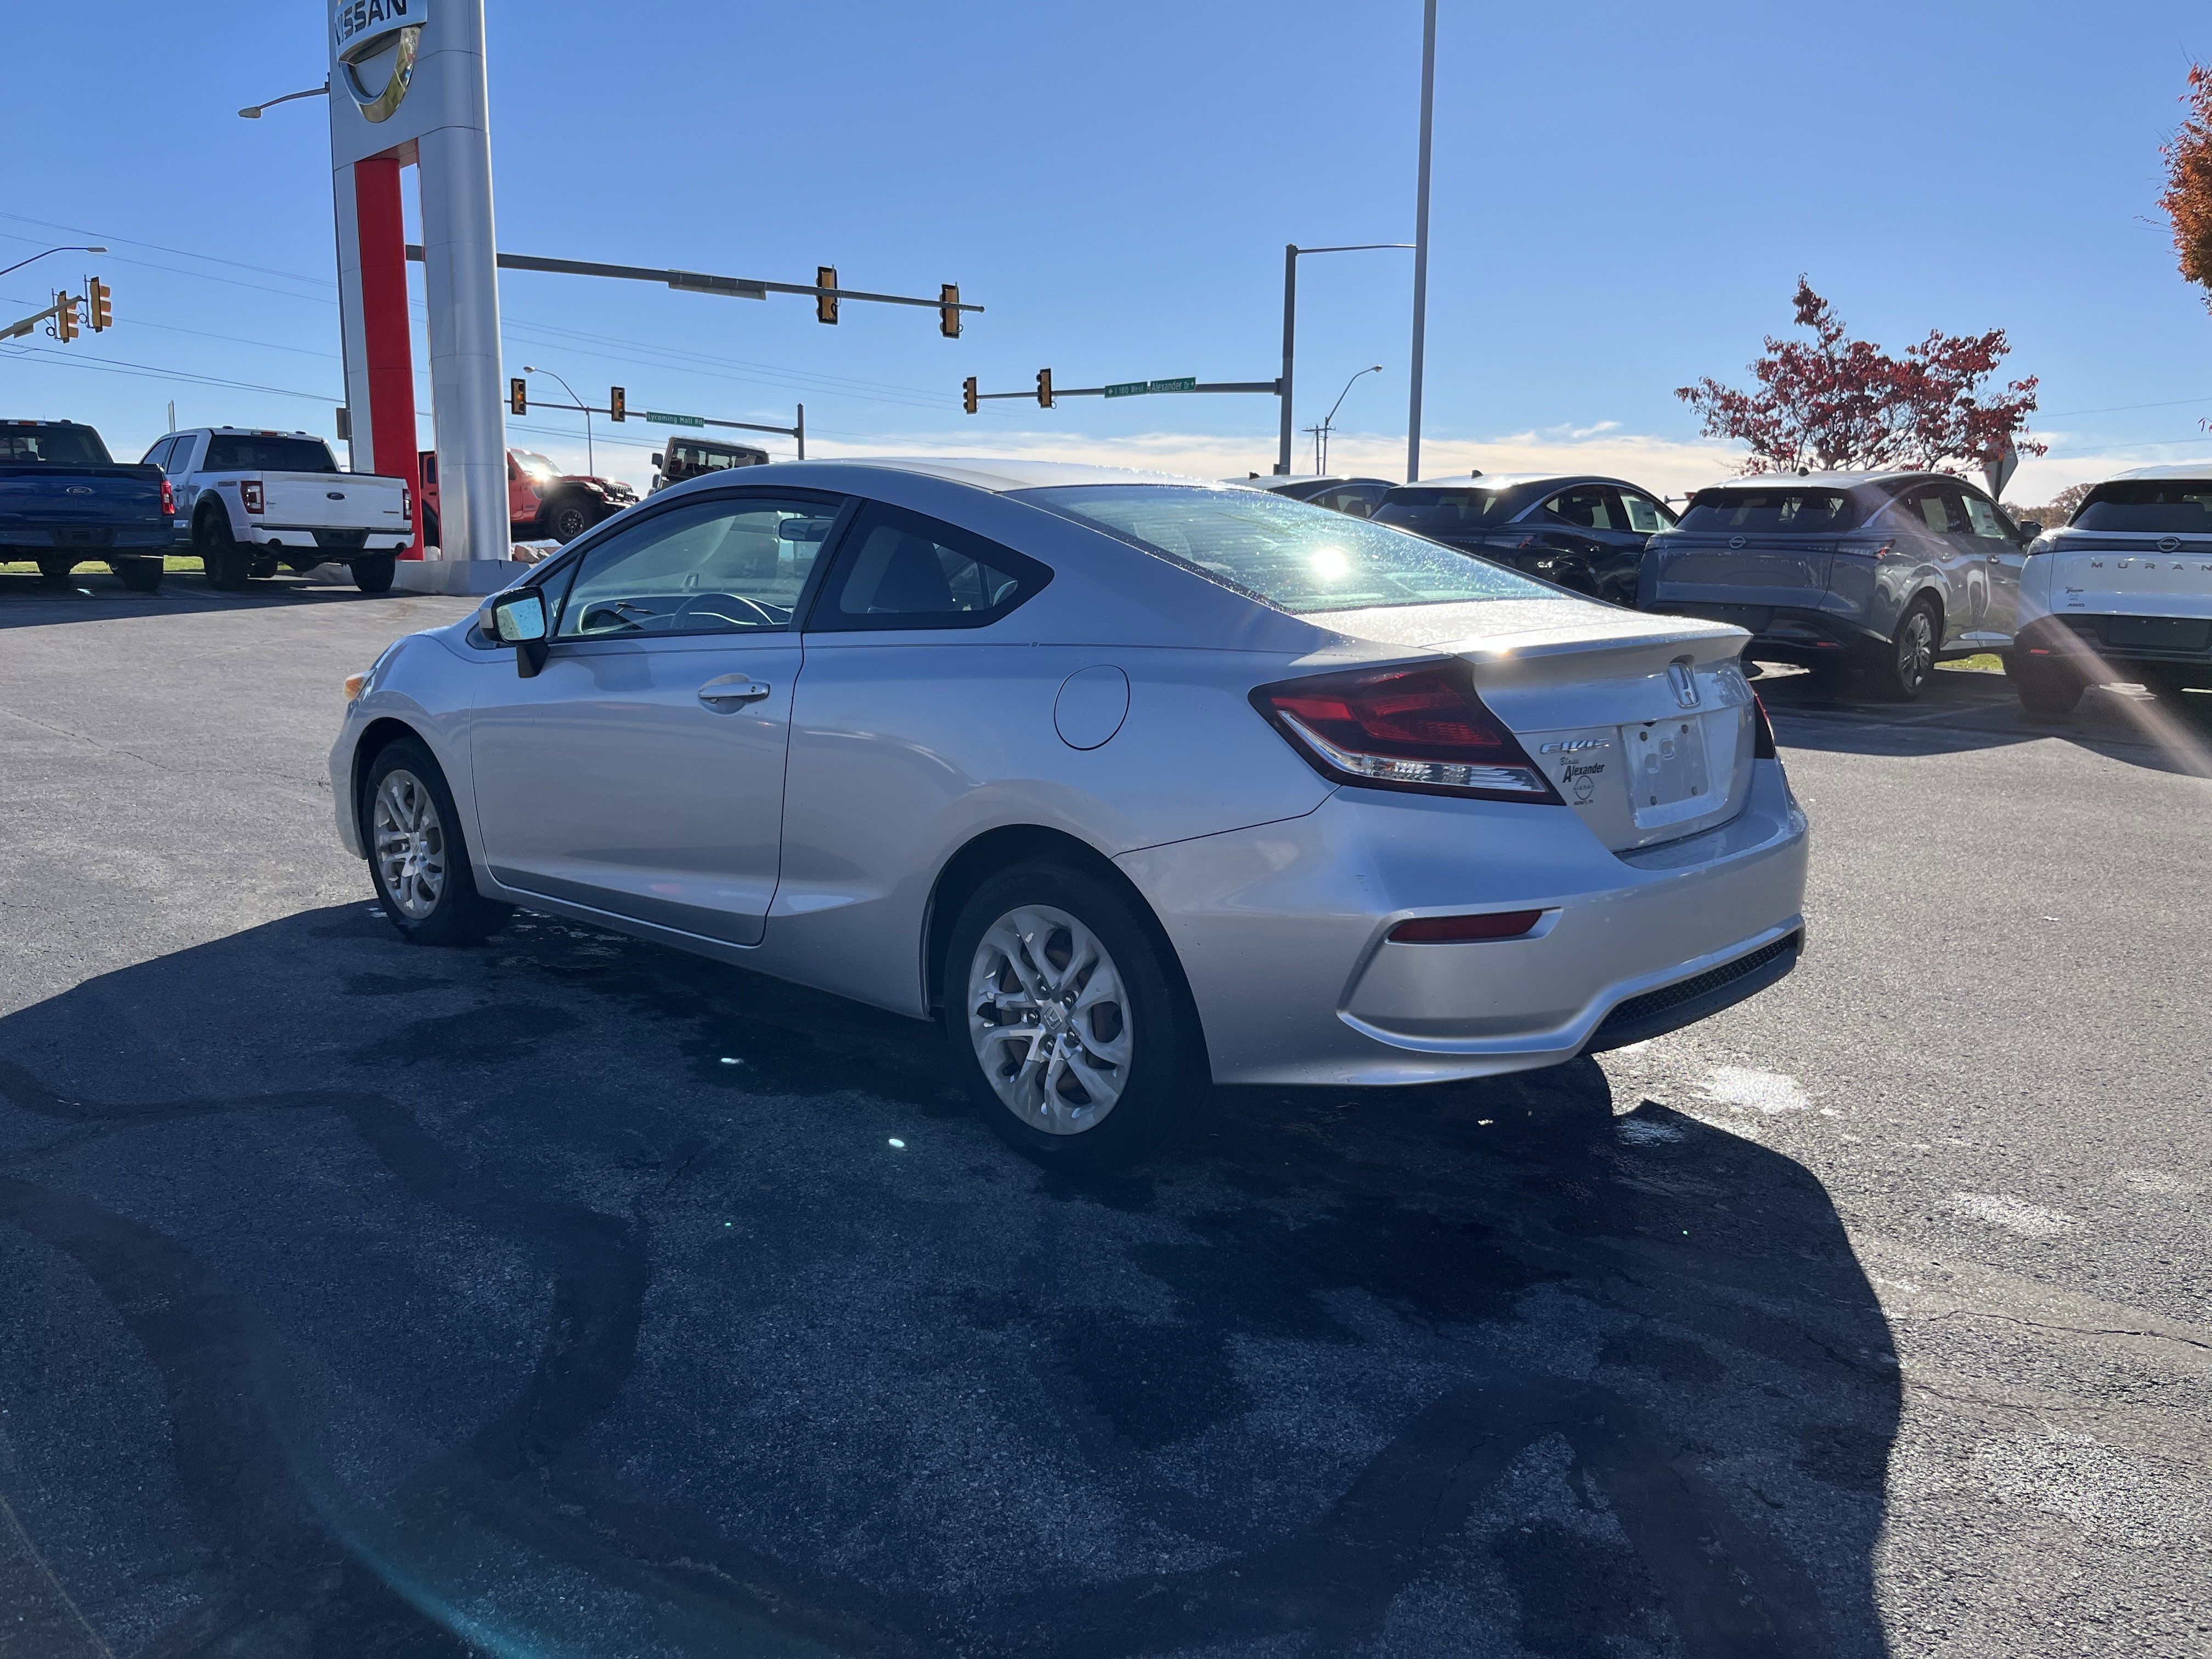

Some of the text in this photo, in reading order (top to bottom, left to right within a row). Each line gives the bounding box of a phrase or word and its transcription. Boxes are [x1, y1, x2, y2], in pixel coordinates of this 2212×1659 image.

[335, 0, 407, 46] NISSAN
[1119, 386, 1129, 394] 180
[1131, 385, 1144, 393] West
[1152, 380, 1190, 392] Alexander Dr
[648, 413, 678, 424] Lycoming
[680, 416, 693, 425] Mall
[1539, 738, 1610, 755] CIVIC
[1560, 757, 1581, 766] Blaise
[1562, 763, 1605, 783] Alexander
